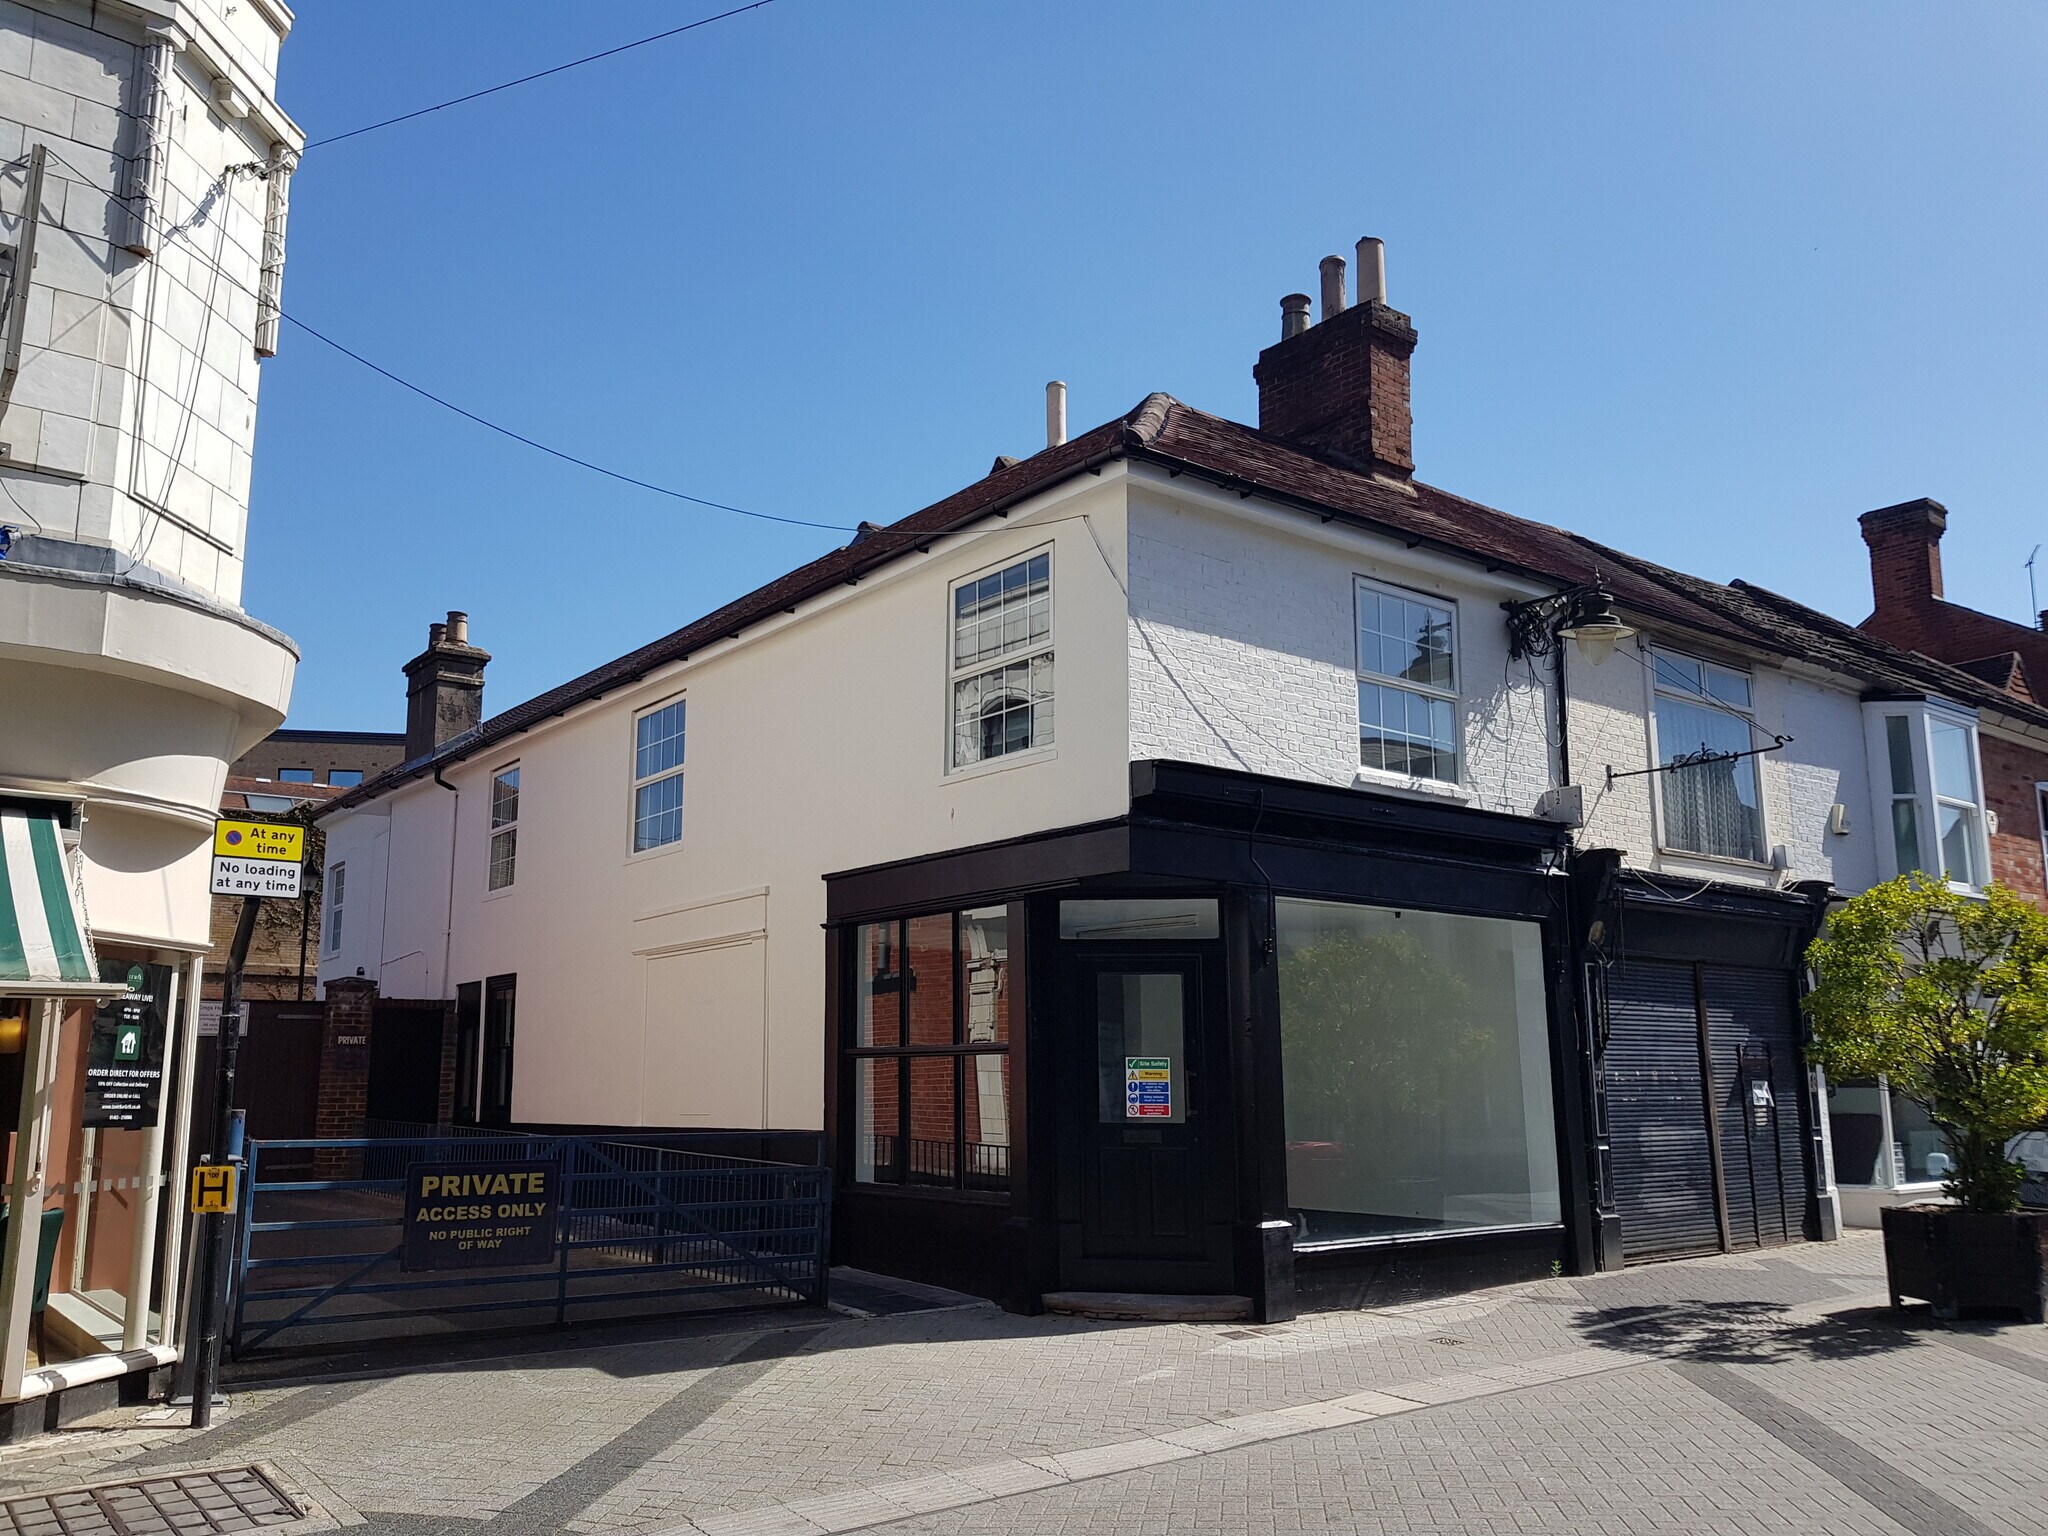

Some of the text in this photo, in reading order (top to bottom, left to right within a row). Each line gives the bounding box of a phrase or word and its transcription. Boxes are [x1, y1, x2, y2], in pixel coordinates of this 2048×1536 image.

[1555, 797, 1561, 805] 2
[250, 827, 296, 843] At any
[256, 843, 287, 855] time
[220, 861, 296, 879] No loading
[216, 877, 296, 892] at any time
[122, 992, 142, 1001] EAWAY
[337, 1035, 367, 1045] PRIVATE
[88, 1068, 161, 1078] ORDER DIRECT FOR OFFERS
[198, 1171, 228, 1207] H
[421, 1172, 545, 1198] PRIVATE
[416, 1202, 547, 1222] ACCESS ONLY
[429, 1226, 532, 1241] NO PUBLIC RIGHT
[458, 1239, 503, 1251] OF WAY
